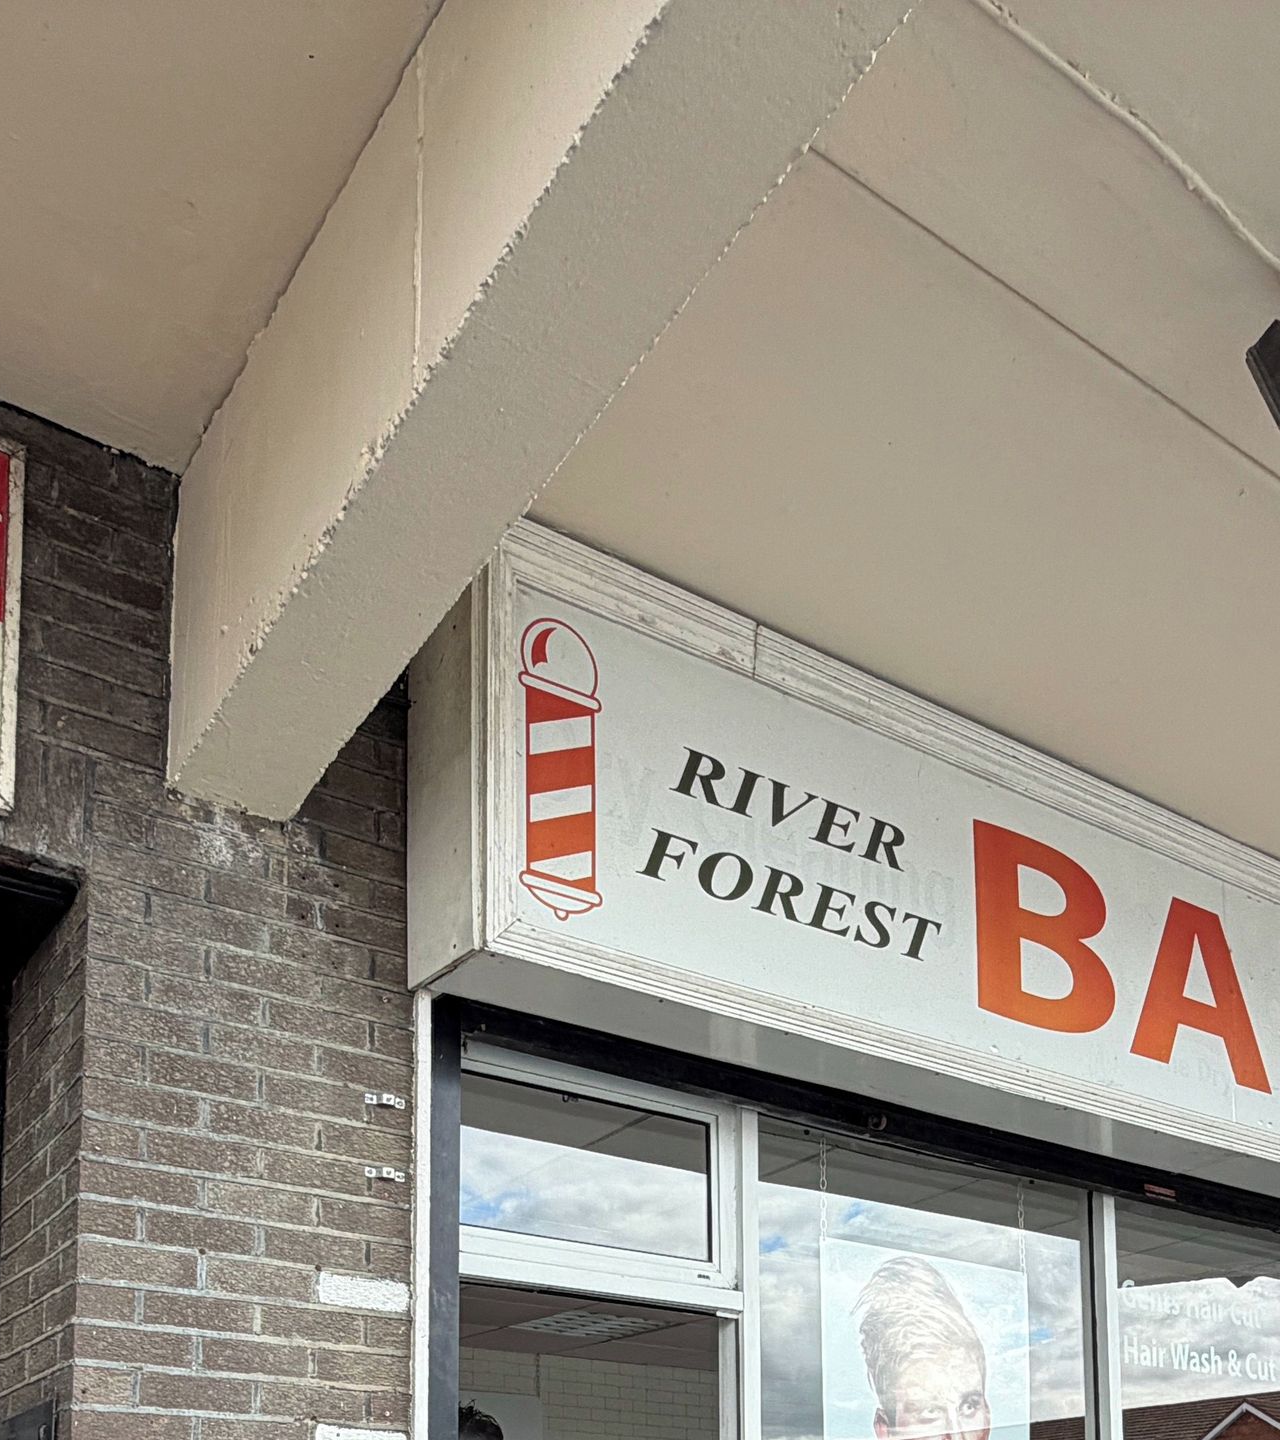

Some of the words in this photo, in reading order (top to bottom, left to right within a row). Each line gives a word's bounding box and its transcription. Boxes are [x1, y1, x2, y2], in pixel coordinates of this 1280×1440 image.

[669, 746, 905, 873] RIVER
[636, 828, 942, 962] FOREST
[1123, 1335, 1167, 1368] Hair
[1169, 1342, 1223, 1376] Wash
[1227, 1349, 1242, 1378] &
[1245, 1352, 1277, 1383] Cut
